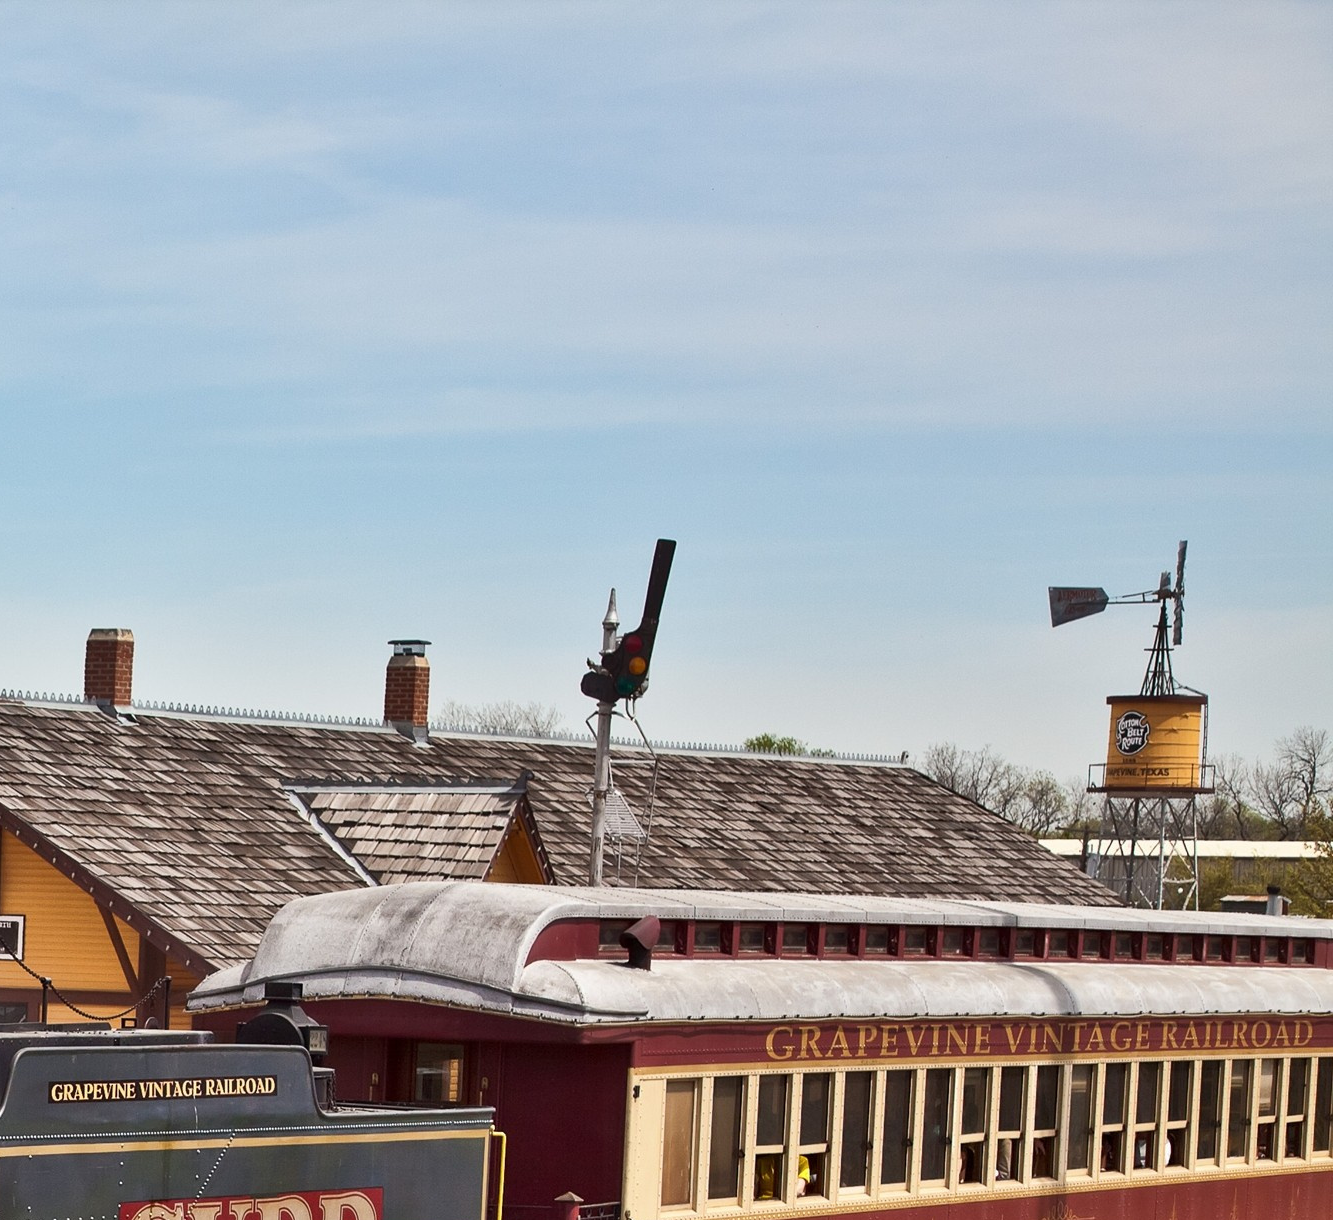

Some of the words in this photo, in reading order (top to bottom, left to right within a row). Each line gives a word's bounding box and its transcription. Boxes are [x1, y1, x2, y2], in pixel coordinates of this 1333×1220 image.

[1127, 728, 1145, 737] BELT
[1121, 737, 1143, 750] ROUTE
[1141, 768, 1170, 777] TEXAS
[765, 1023, 992, 1060] GRAPEVINE
[1002, 1021, 1153, 1054] VINTAGE
[1160, 1019, 1314, 1050] RAILROAD
[50, 1082, 136, 1102] GRAPEVINE
[139, 1079, 203, 1099] VINTAGE
[205, 1077, 276, 1096] RAILROAD
